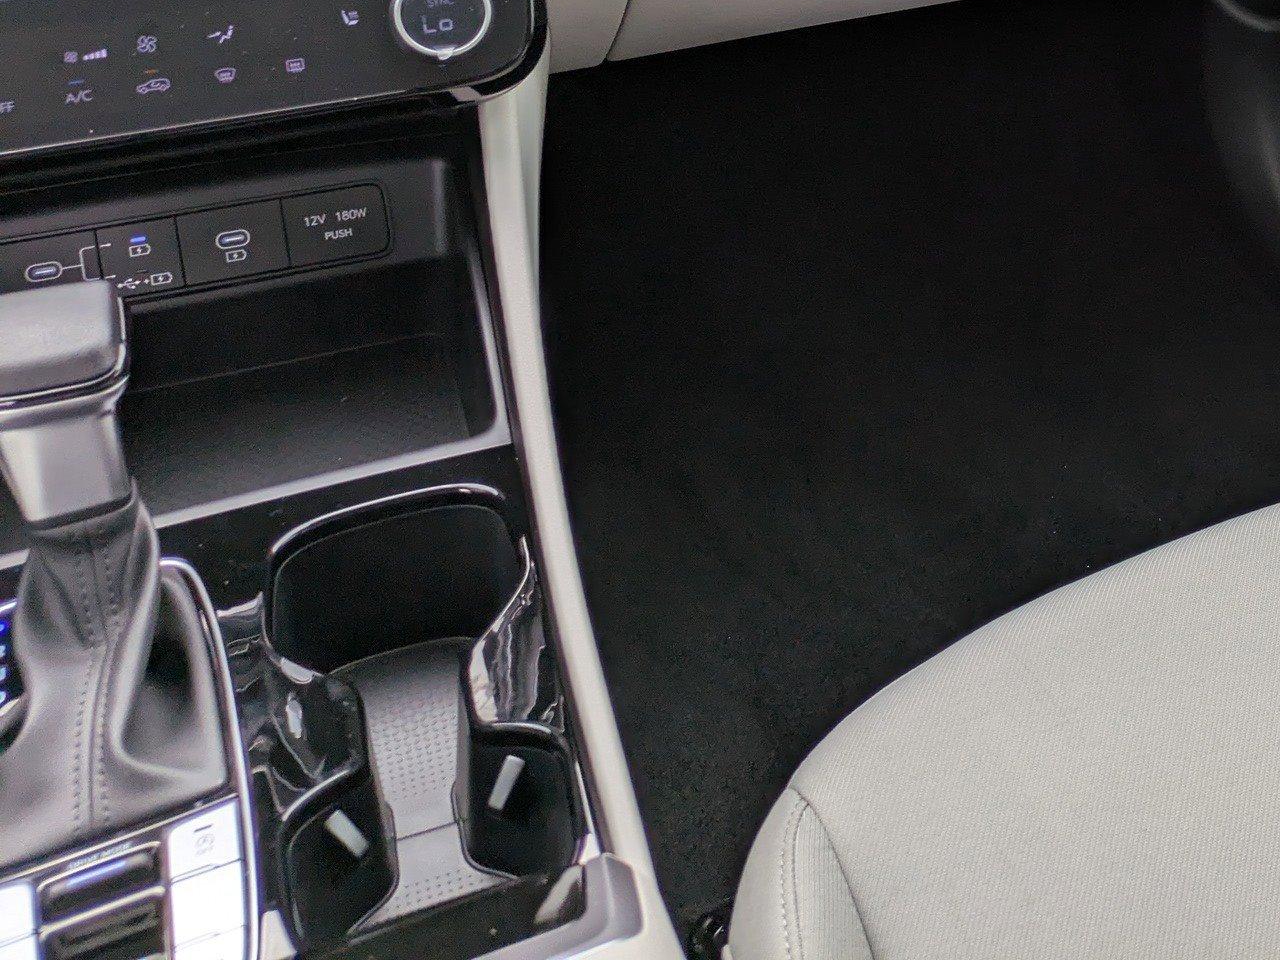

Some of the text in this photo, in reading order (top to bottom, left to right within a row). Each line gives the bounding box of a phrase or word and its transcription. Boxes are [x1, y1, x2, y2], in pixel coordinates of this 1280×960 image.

[64, 88, 93, 106] A/C
[304, 207, 367, 227] 12V 180W
[324, 227, 353, 240] PUSH
